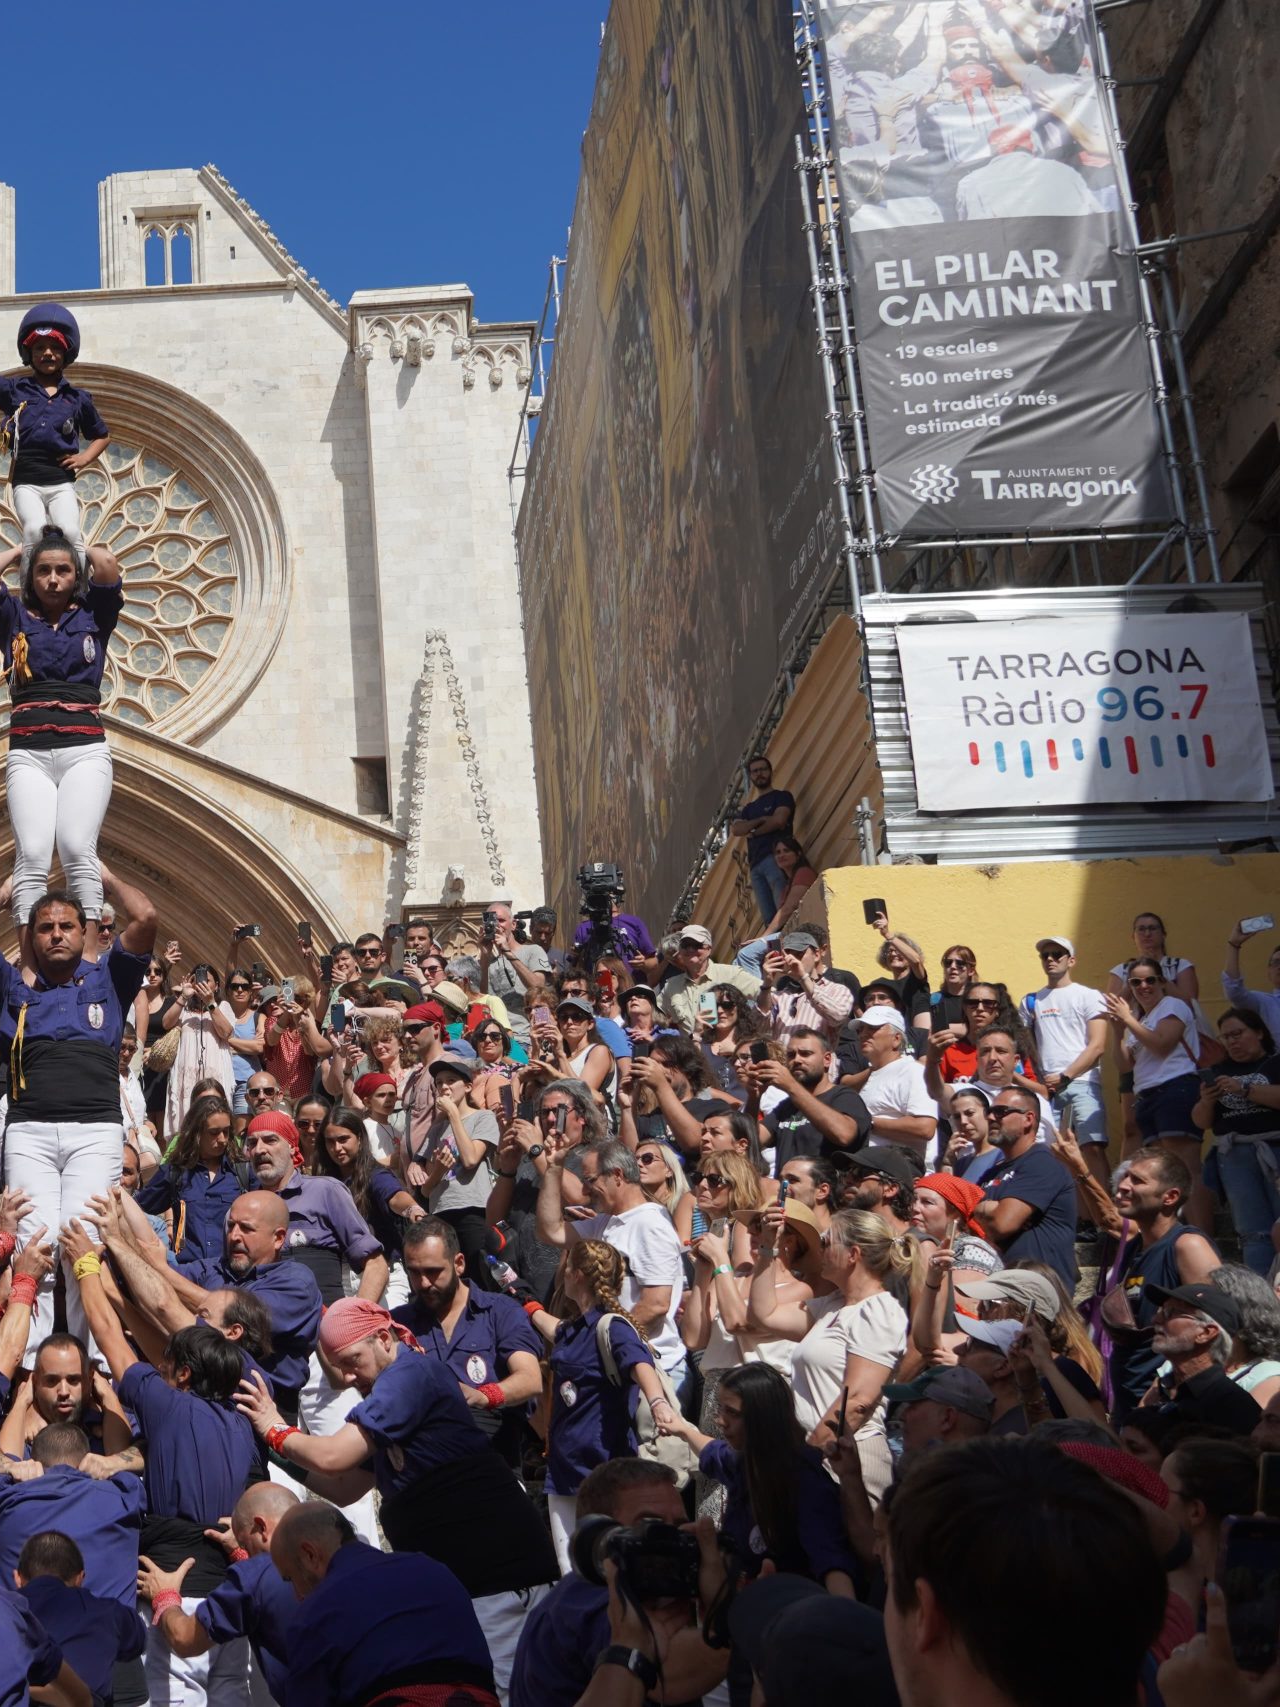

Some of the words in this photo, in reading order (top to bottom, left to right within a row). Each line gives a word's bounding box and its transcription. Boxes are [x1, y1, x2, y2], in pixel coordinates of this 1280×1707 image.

[874, 258, 926, 291] EL
[934, 249, 1061, 285] PILAR
[877, 279, 1119, 327] CAMINANT
[895, 344, 918, 360] 19
[922, 339, 999, 359] escales
[900, 371, 937, 388] 500
[942, 367, 1015, 385] metres
[903, 401, 928, 416] La
[931, 391, 1013, 413] tradició
[1017, 389, 1058, 407] més
[904, 413, 1002, 435] estimada
[1007, 467, 1093, 479] AJUNTAMENT
[1098, 466, 1118, 476] DE
[947, 646, 1207, 682] TARRAGONA
[961, 689, 1086, 728] Ràdio
[1095, 683, 1210, 722] 96.7
